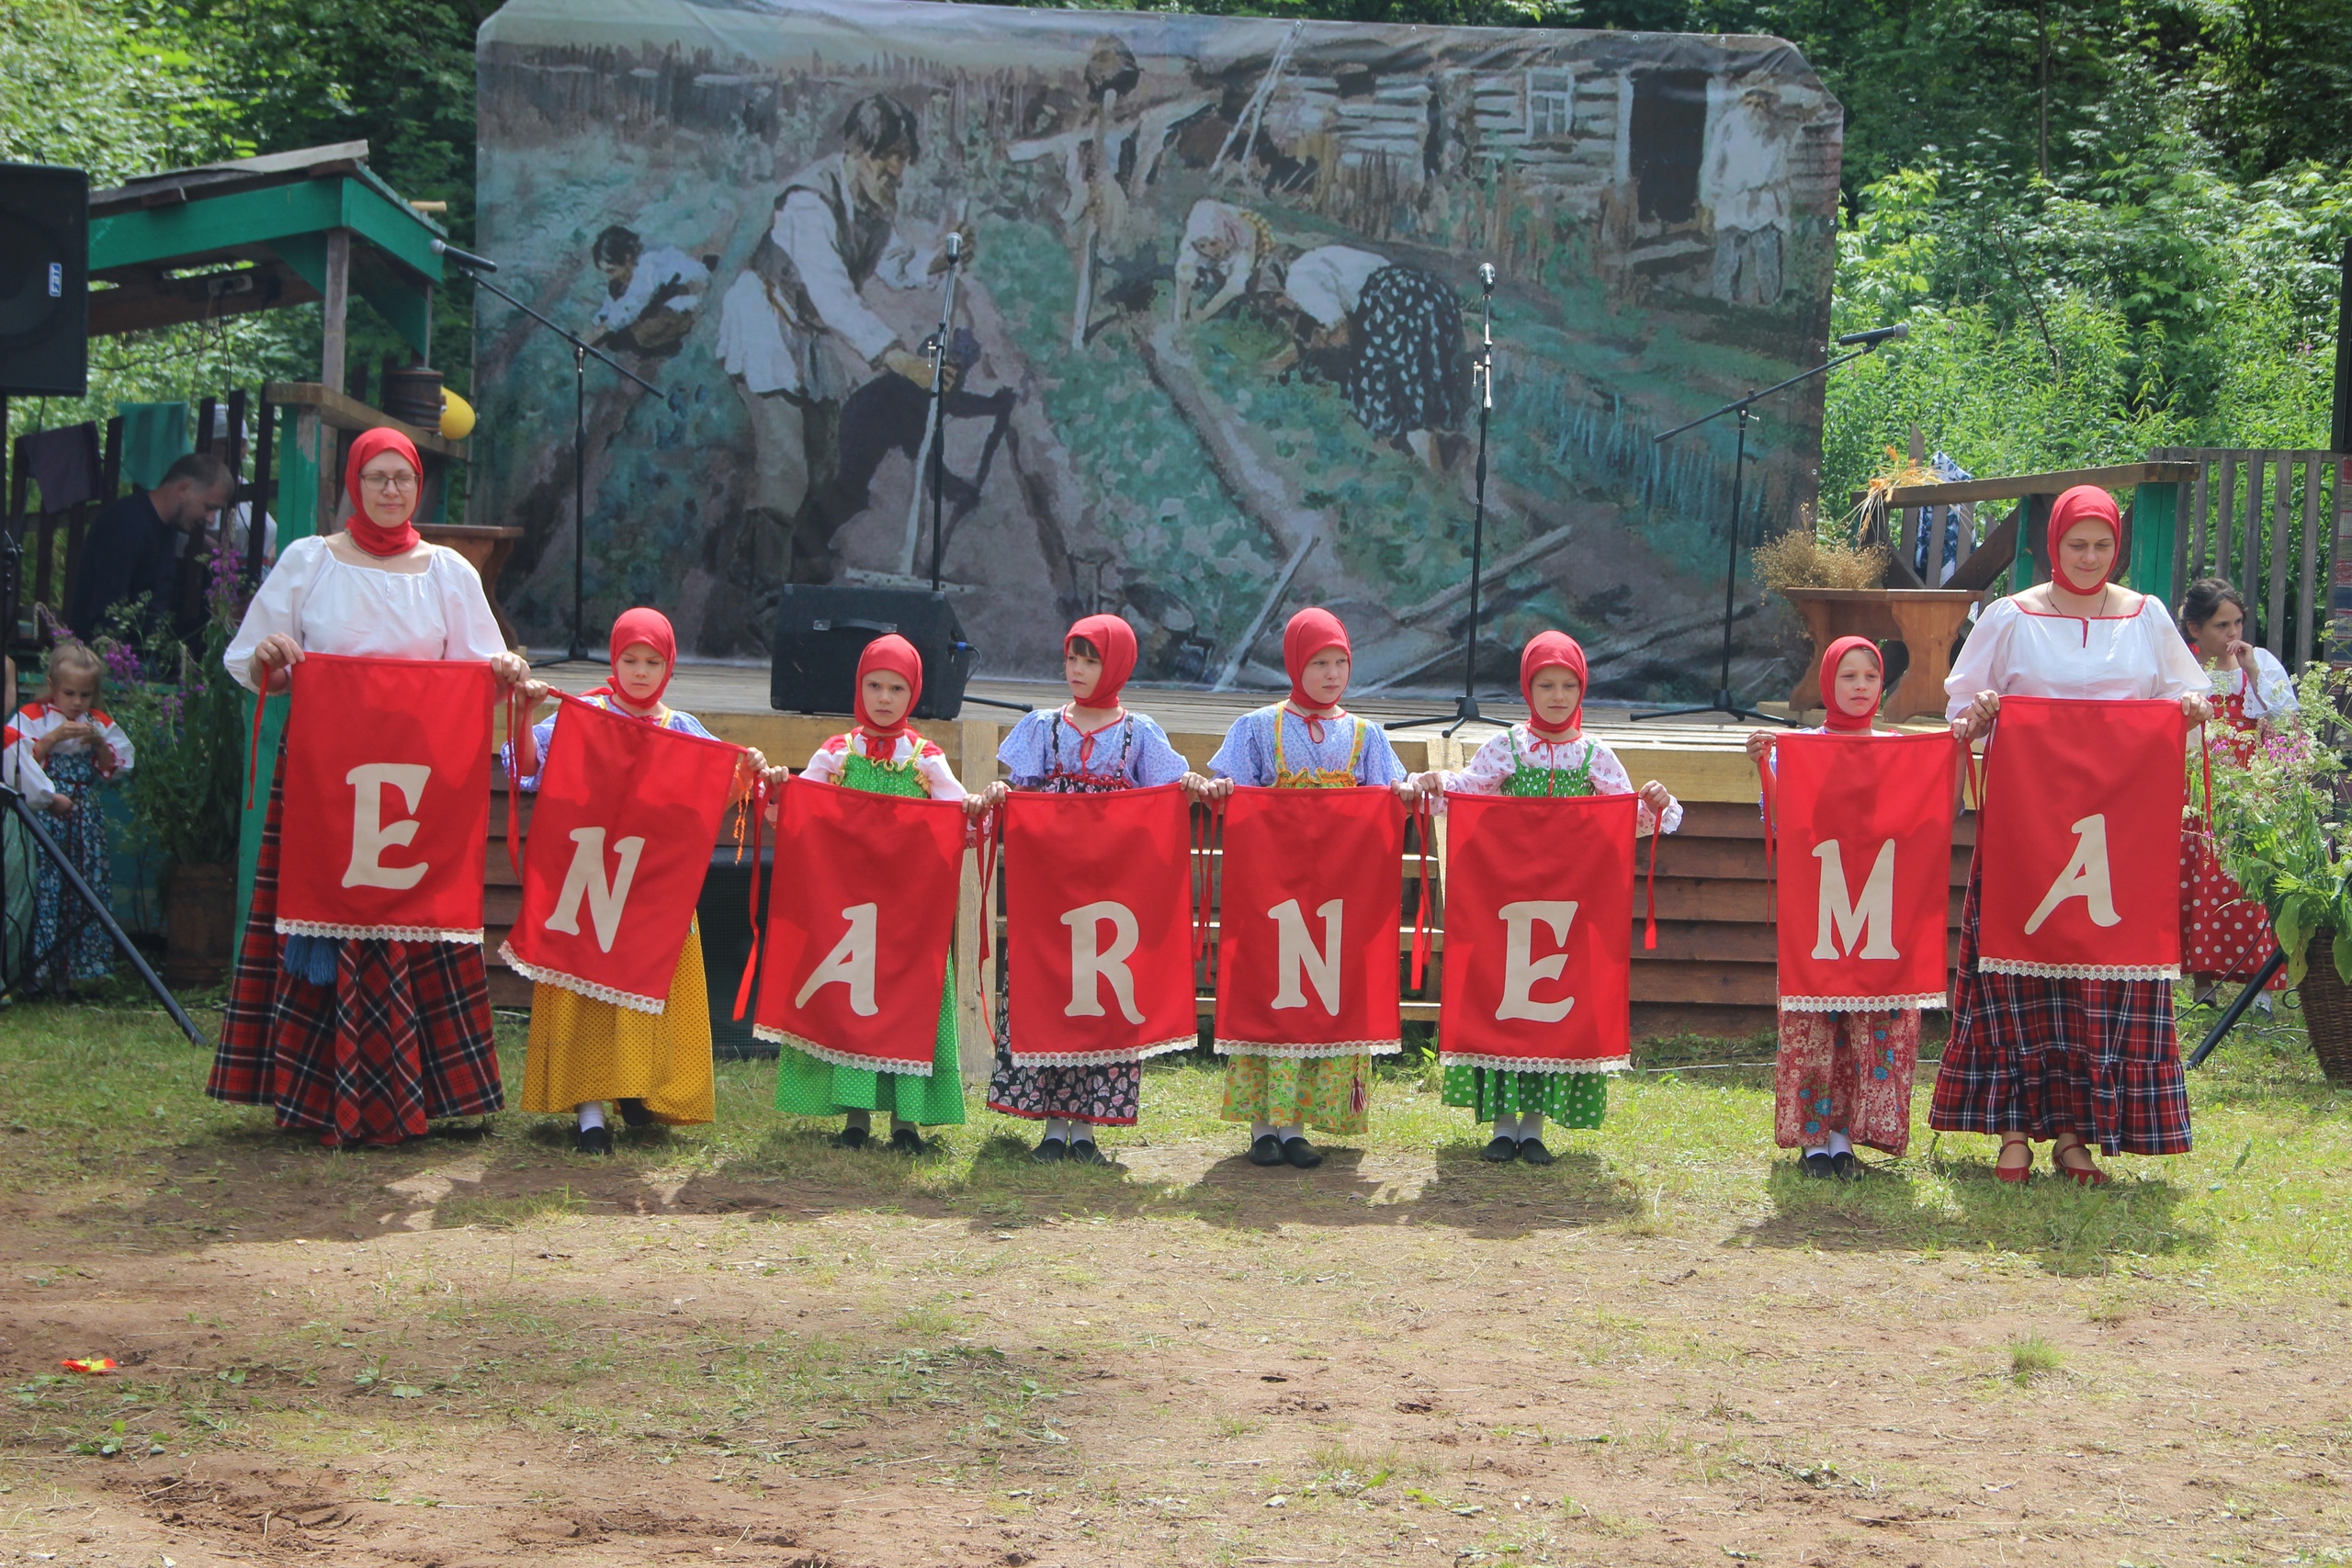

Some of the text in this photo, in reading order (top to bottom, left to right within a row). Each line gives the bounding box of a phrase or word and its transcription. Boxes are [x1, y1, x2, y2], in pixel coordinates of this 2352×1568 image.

[342, 763, 431, 889] E
[2025, 814, 2121, 934] A
[545, 827, 645, 953] N
[1811, 839, 1900, 960] M
[796, 903, 878, 1016] A
[1060, 901, 1146, 1024] R
[1268, 898, 1343, 1016] N
[1496, 901, 1578, 1022] E
